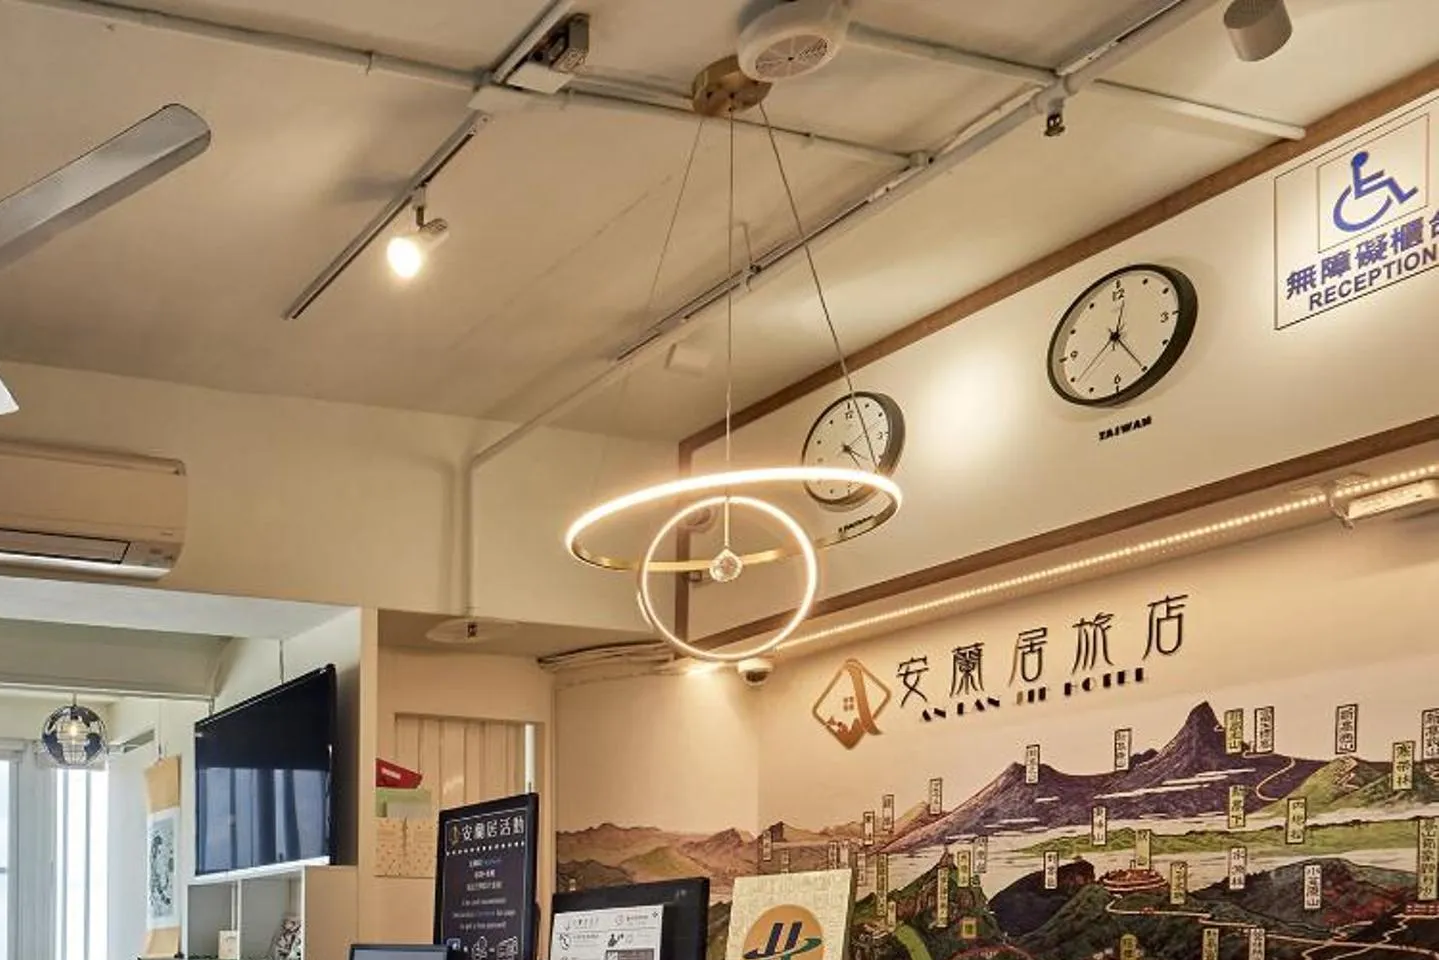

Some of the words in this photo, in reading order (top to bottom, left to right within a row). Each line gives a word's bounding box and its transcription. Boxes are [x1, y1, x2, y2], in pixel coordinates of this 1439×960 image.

[1309, 244, 1438, 311] RECEPTION
[1099, 415, 1152, 441] TAIWAN
[896, 594, 1189, 707] 安蘭居旅店
